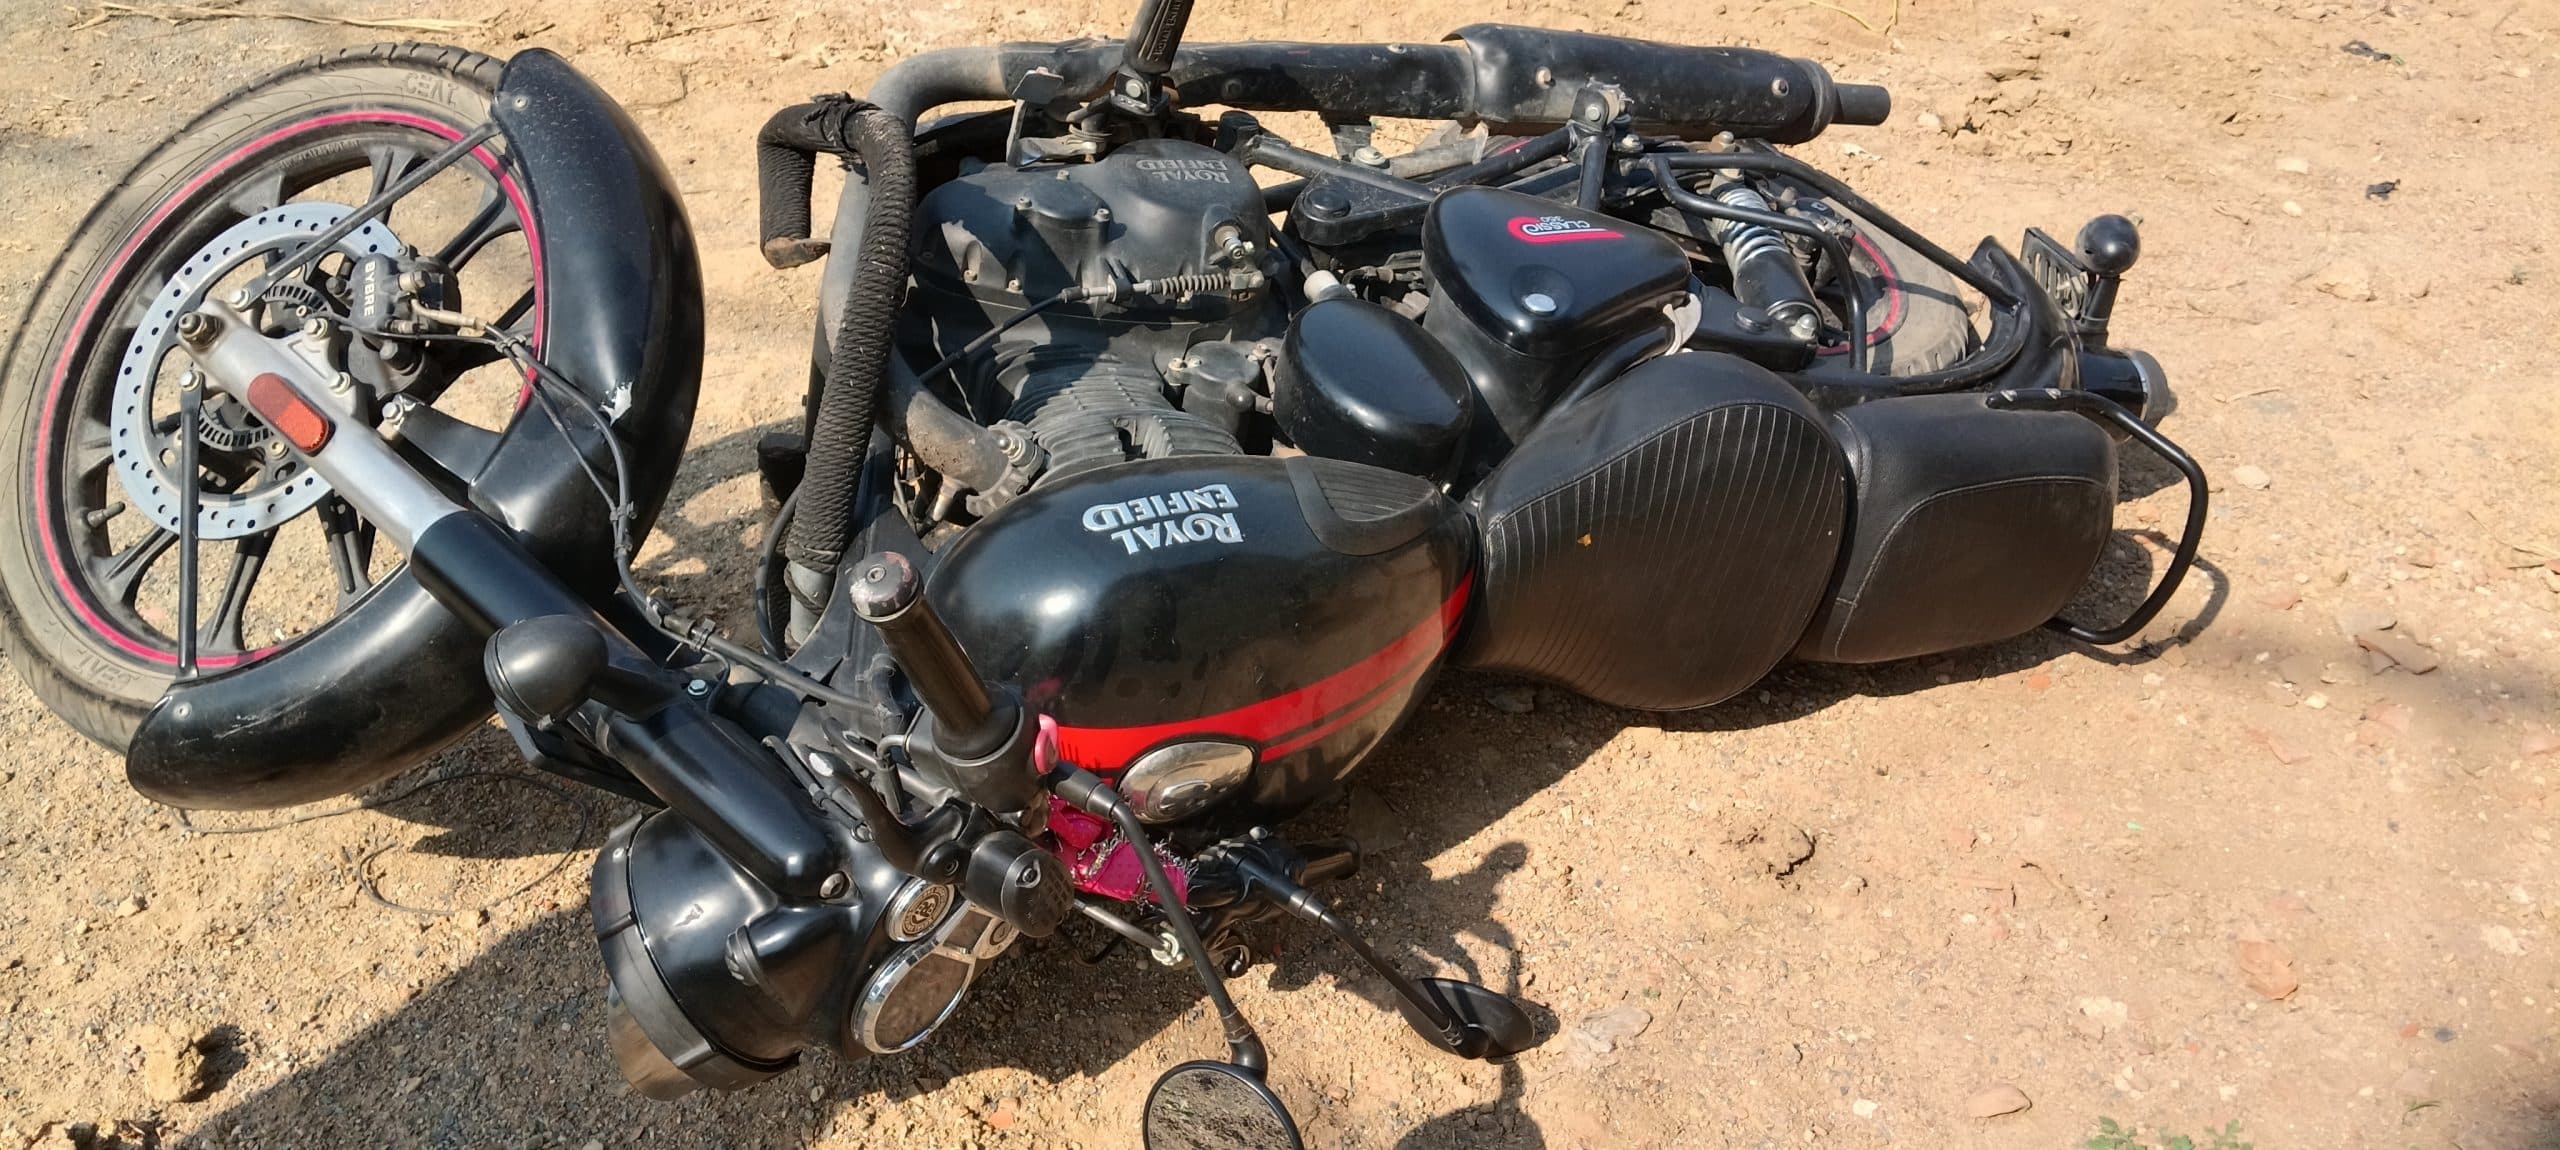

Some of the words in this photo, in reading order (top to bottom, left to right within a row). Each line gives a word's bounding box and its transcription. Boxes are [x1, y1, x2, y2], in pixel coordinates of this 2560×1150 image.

[1135, 159, 1229, 171] ENFIELD
[1152, 169, 1231, 184] ROYAL
[1522, 220, 1591, 236] CLASSIC
[364, 260, 376, 317] BYBRE
[1081, 483, 1239, 532] ENFIELD
[1110, 512, 1244, 555] ROYAL
